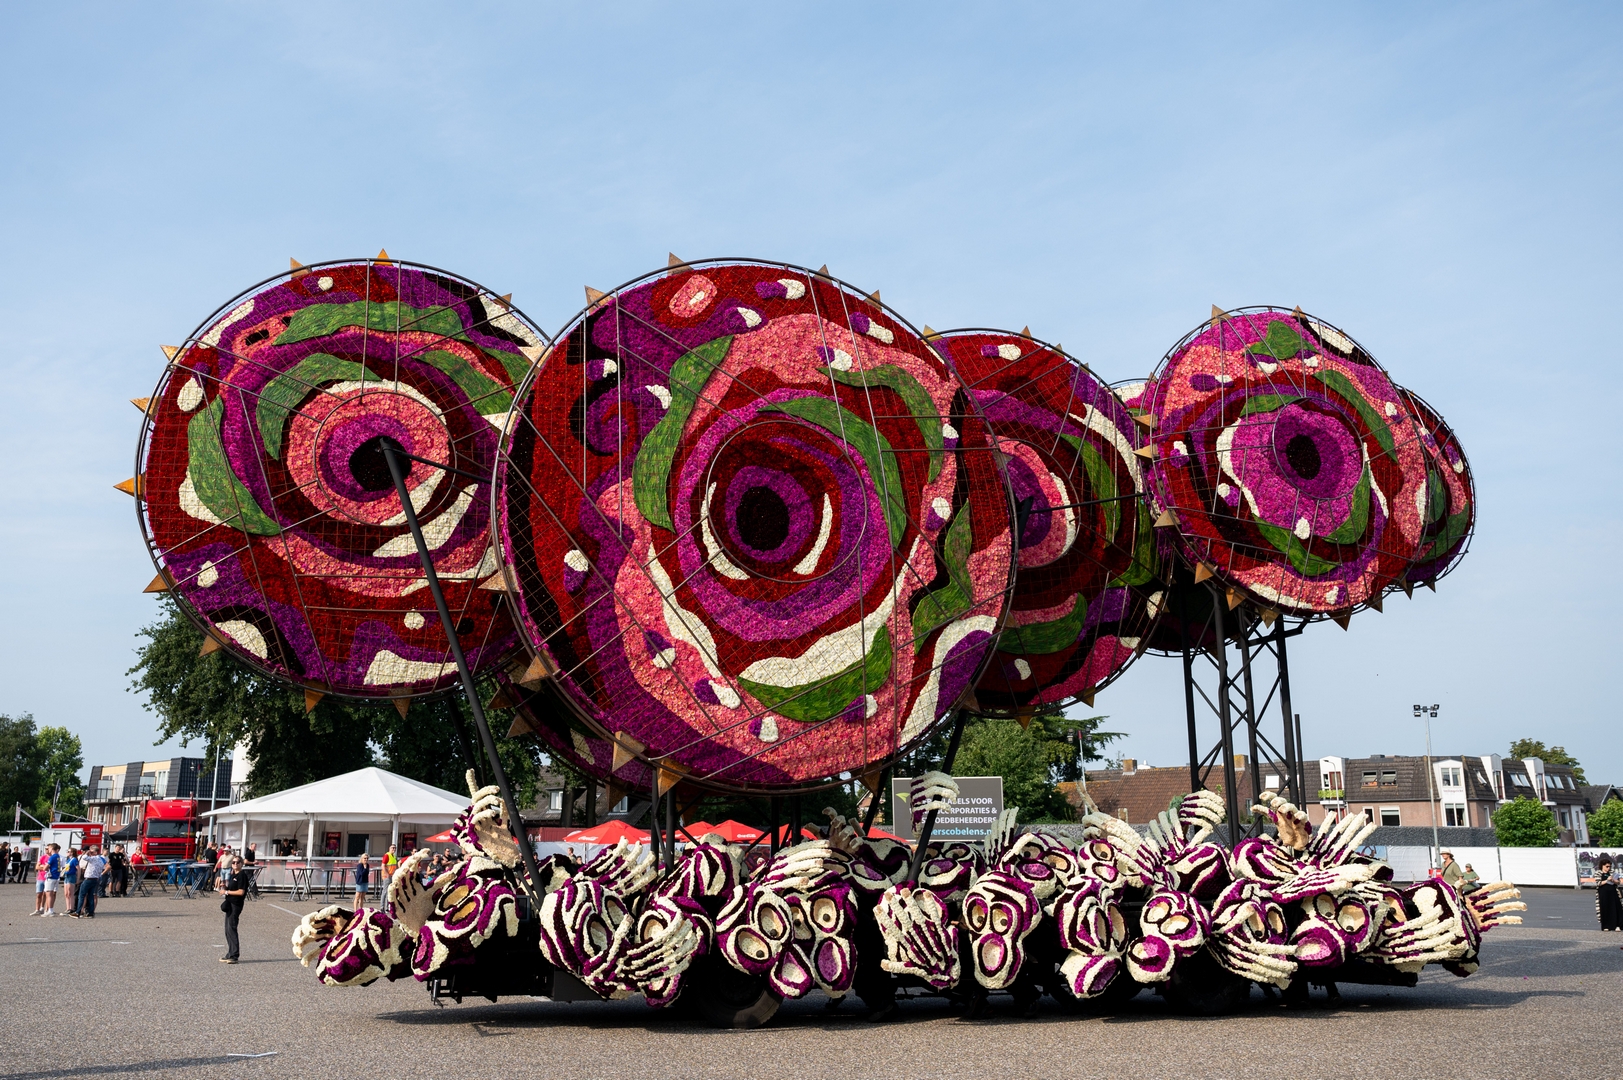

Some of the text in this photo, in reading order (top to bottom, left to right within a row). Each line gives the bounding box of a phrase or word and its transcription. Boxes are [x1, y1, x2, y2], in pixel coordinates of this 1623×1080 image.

[971, 797, 993, 805] VOOR
[991, 807, 998, 815] &
[930, 826, 992, 835] erscobelens.n
